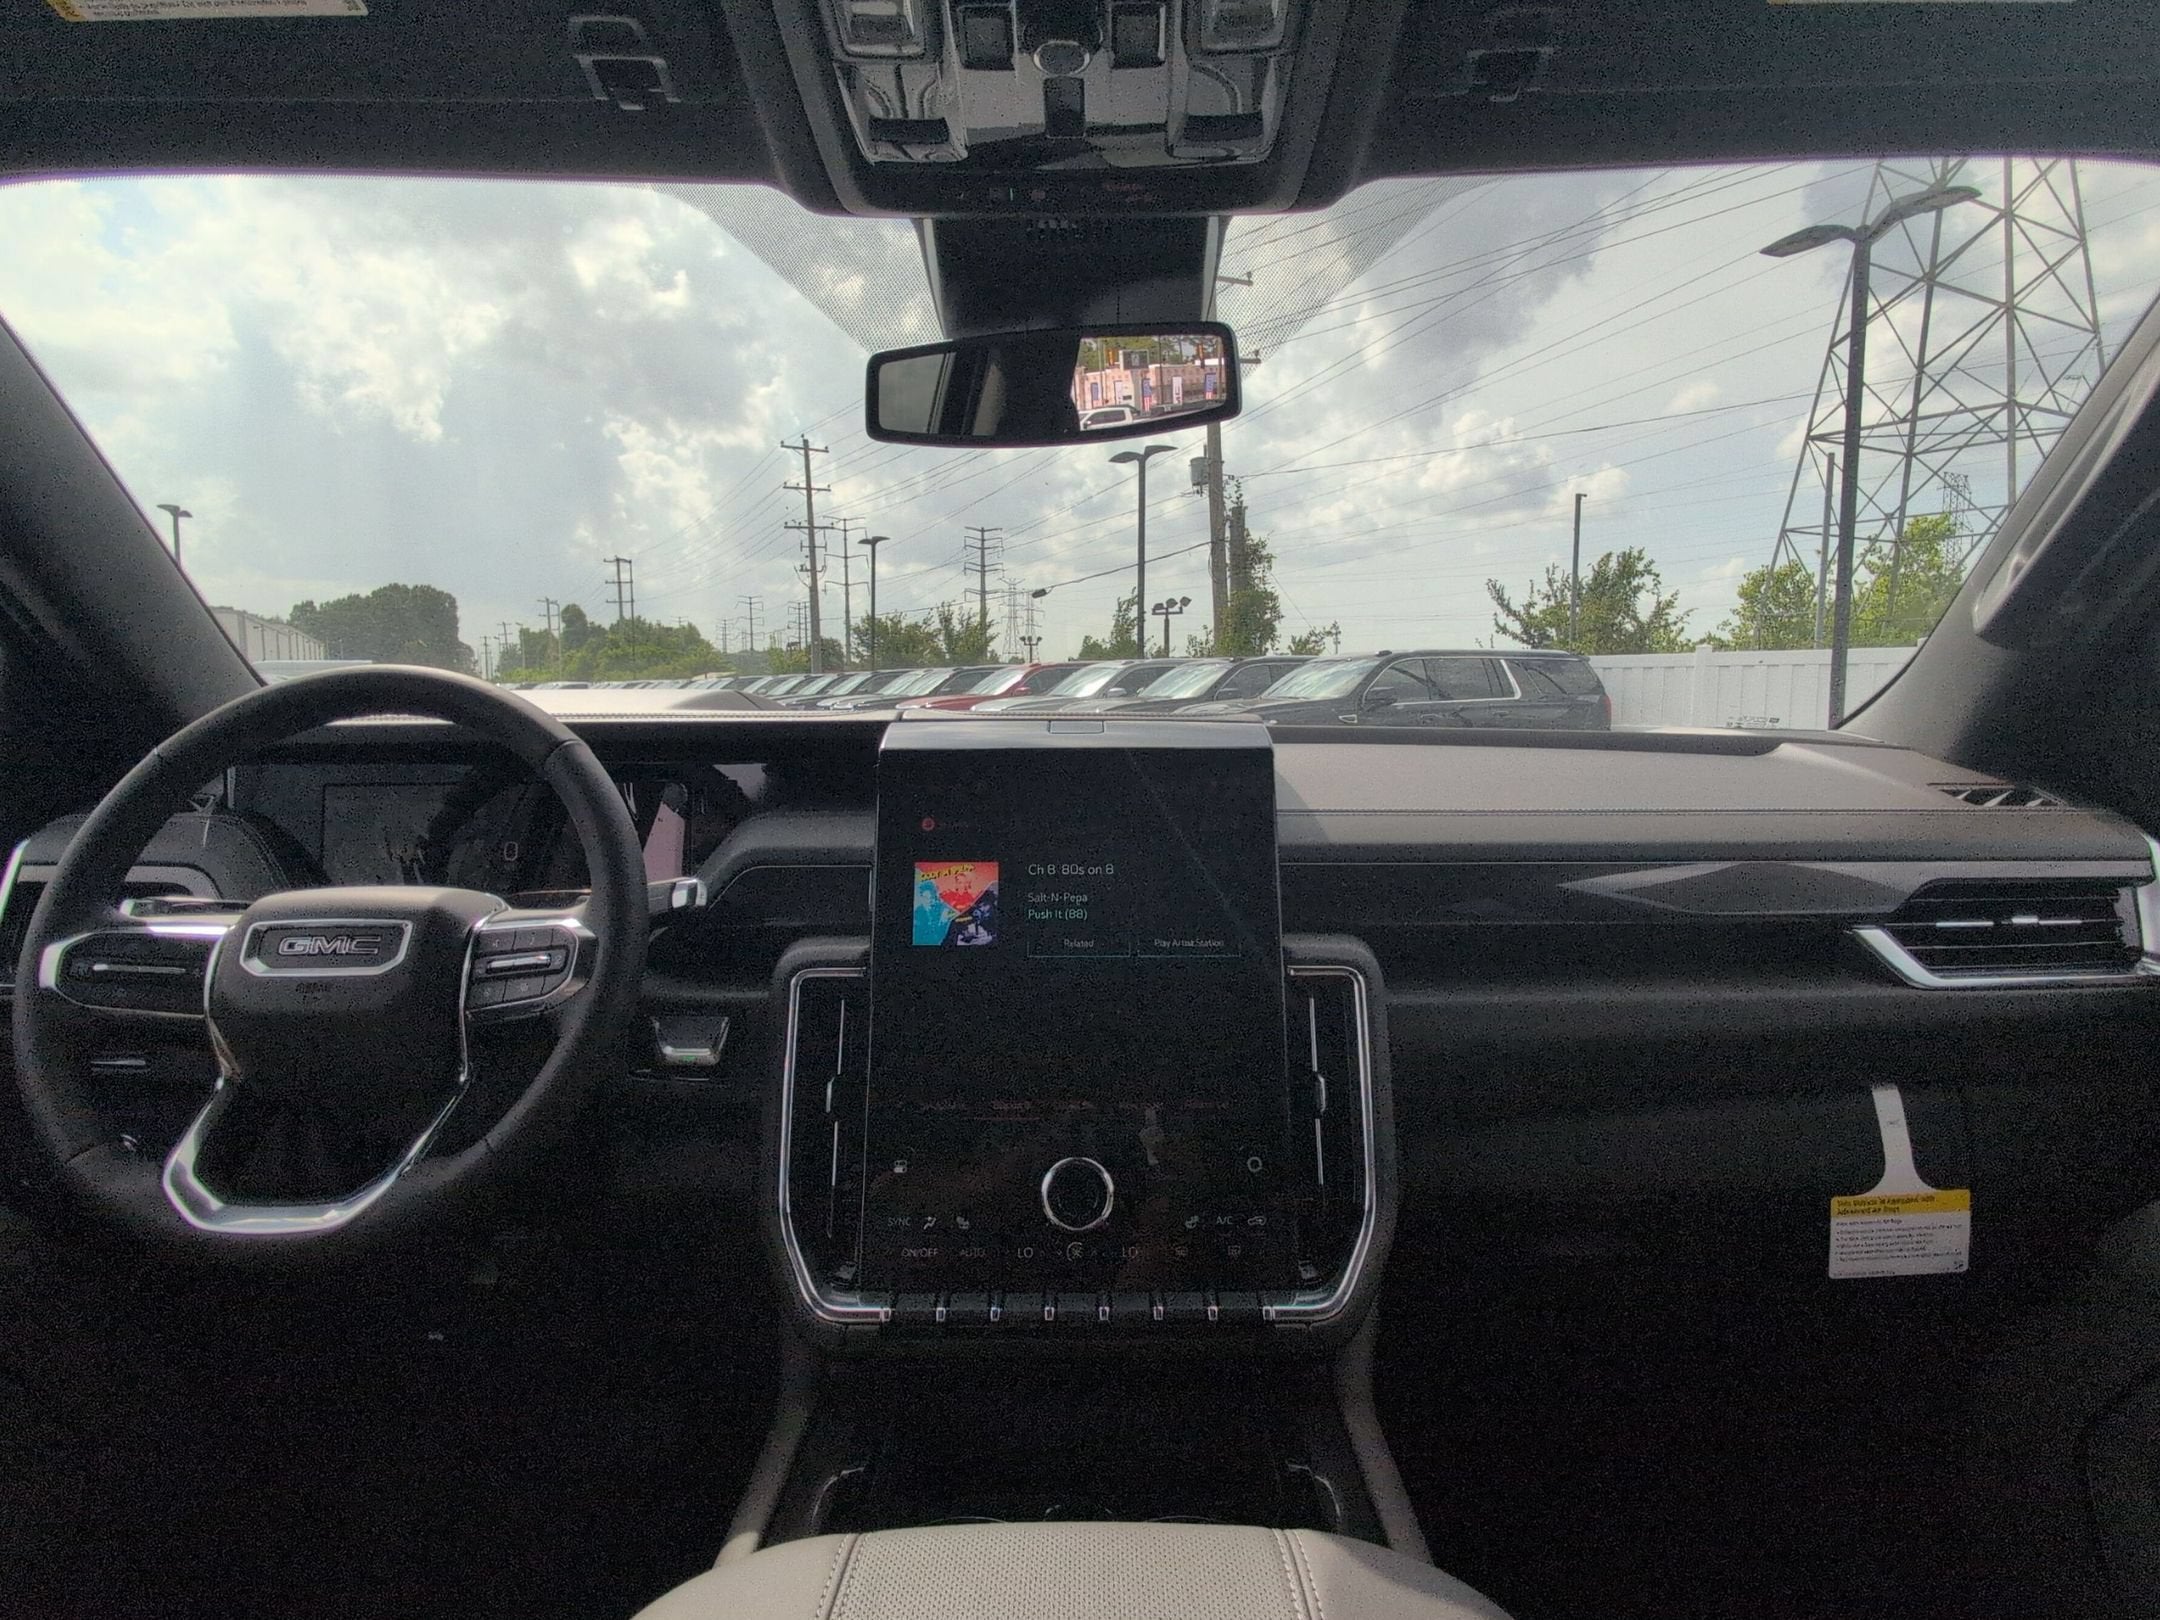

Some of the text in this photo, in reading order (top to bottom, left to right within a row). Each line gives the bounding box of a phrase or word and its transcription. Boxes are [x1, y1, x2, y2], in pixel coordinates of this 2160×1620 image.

[1028, 864, 1044, 876] Ch
[1061, 864, 1085, 876] 80s
[1087, 866, 1102, 876] on
[1105, 863, 1115, 876] 8
[1027, 892, 1088, 906] Salt-N-Pepa
[1027, 910, 1053, 921] Push
[1054, 910, 1064, 921] It
[278, 935, 382, 956] GMC
[887, 1216, 912, 1227] SYNC
[1216, 1215, 1233, 1226] A/C
[1016, 1246, 1034, 1259] LO
